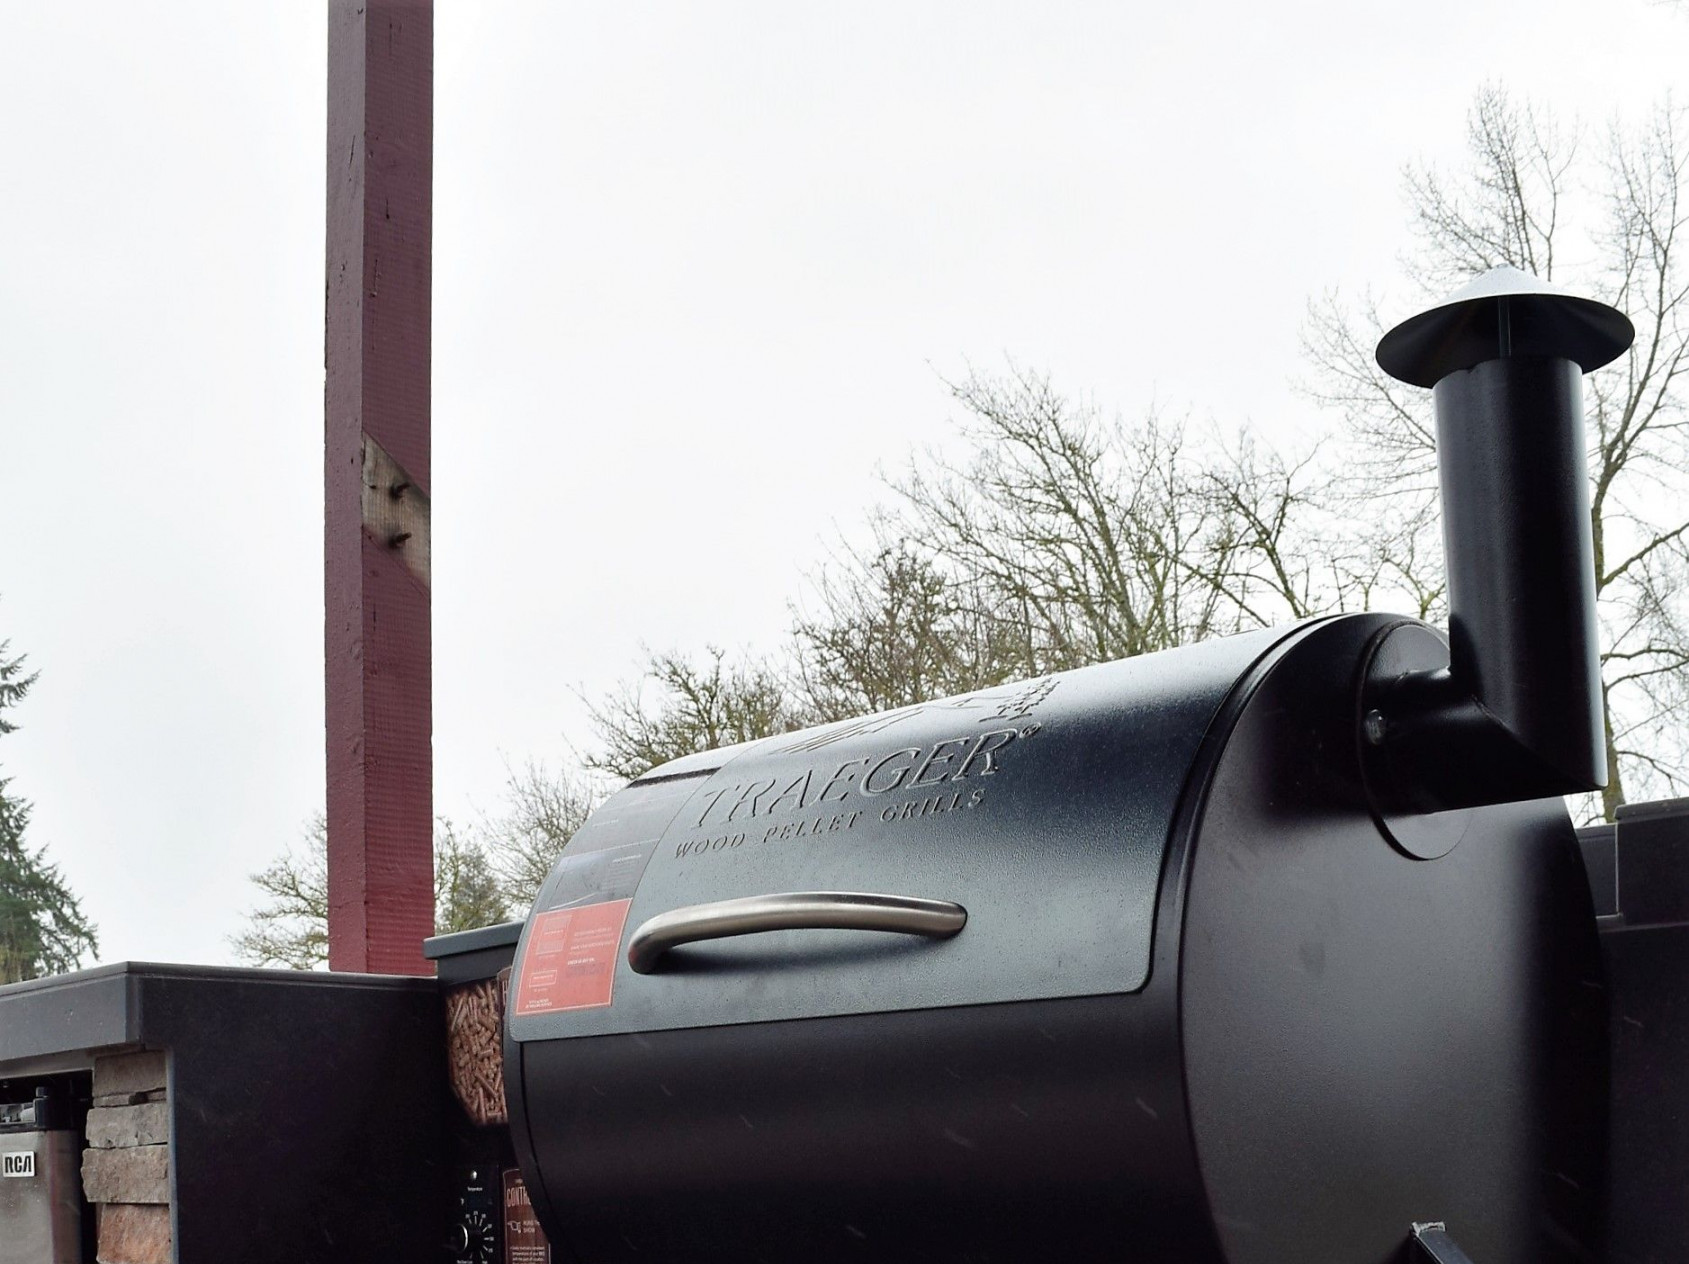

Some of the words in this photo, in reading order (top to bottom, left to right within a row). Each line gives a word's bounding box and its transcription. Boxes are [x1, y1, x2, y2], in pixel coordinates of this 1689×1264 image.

[675, 833, 746, 859] WOOD
[763, 810, 863, 844] PELLET
[880, 788, 985, 823] GRILLS
[5, 1155, 32, 1173] RCA
